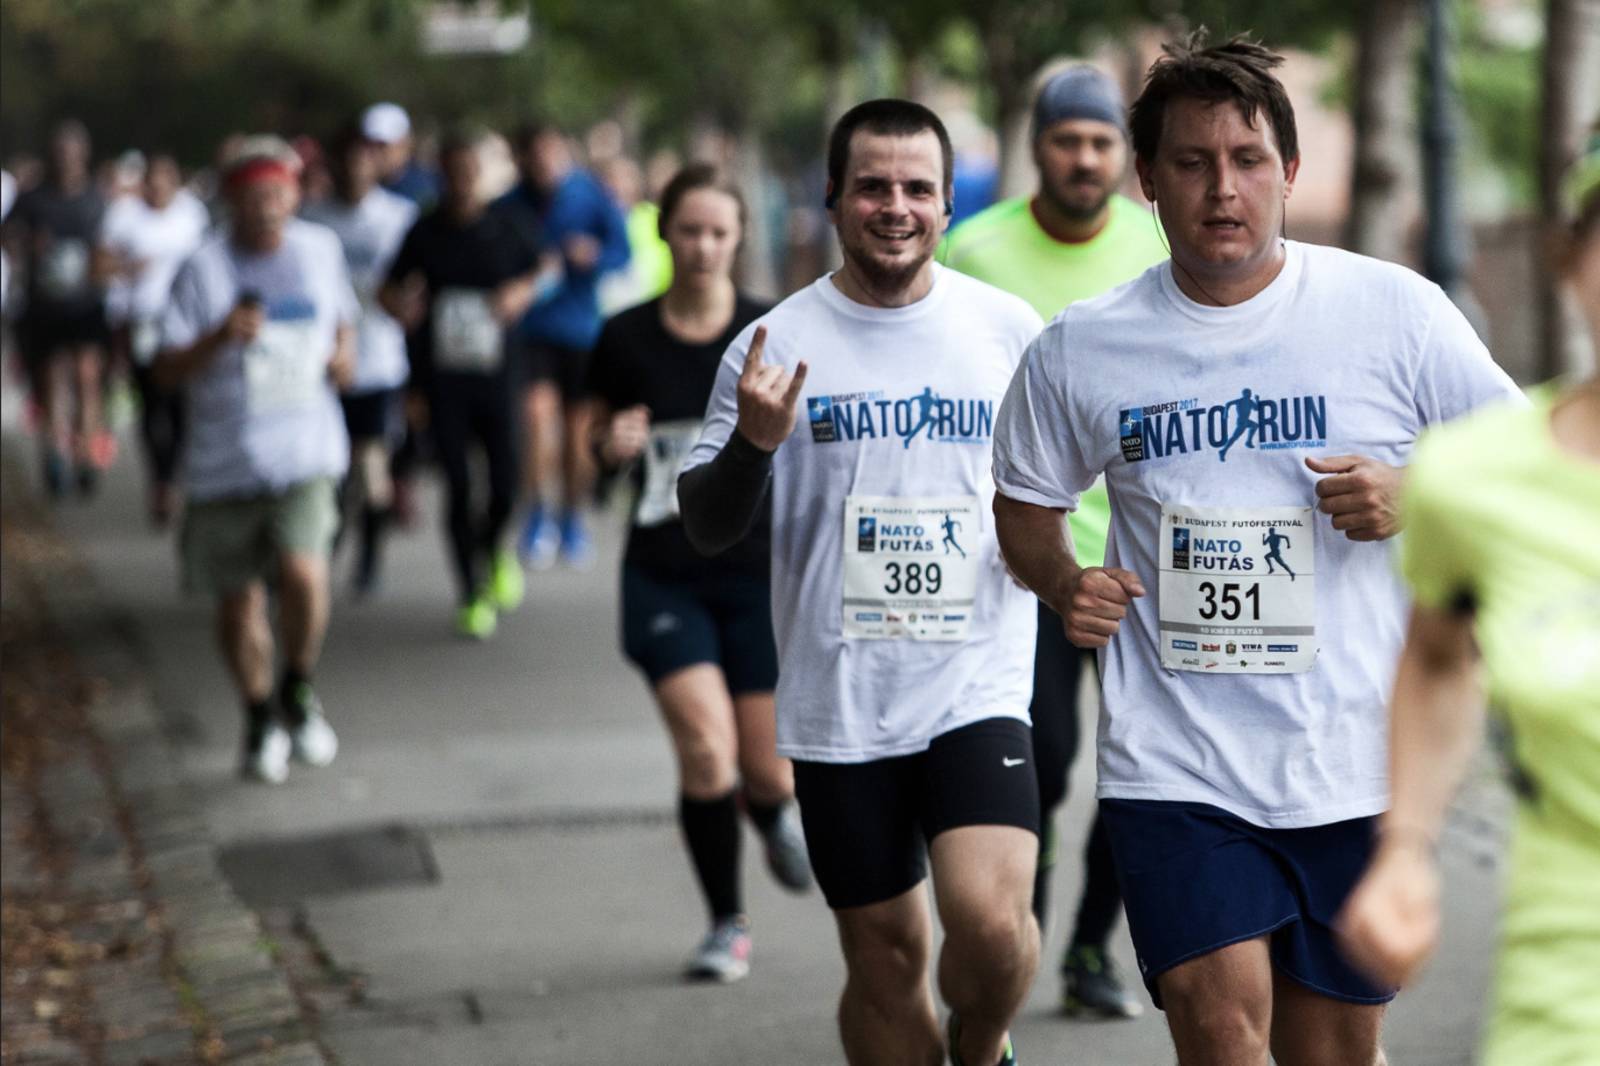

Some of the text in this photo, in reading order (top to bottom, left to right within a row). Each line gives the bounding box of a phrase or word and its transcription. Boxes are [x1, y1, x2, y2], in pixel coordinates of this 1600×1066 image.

[1143, 398, 1198, 416] BUDAPEST 2017
[833, 399, 993, 441] NATO RUN
[1143, 396, 1326, 460] NATO RUN
[880, 525, 924, 537] NATO
[1185, 518, 1303, 528] BUDAPEST FUTÓFESZTIVÁL
[880, 538, 934, 552] FUTÁS
[1193, 538, 1242, 553] NATO
[1193, 554, 1254, 571] FUTÁS
[884, 562, 942, 595] 389
[1198, 581, 1260, 621] 351
